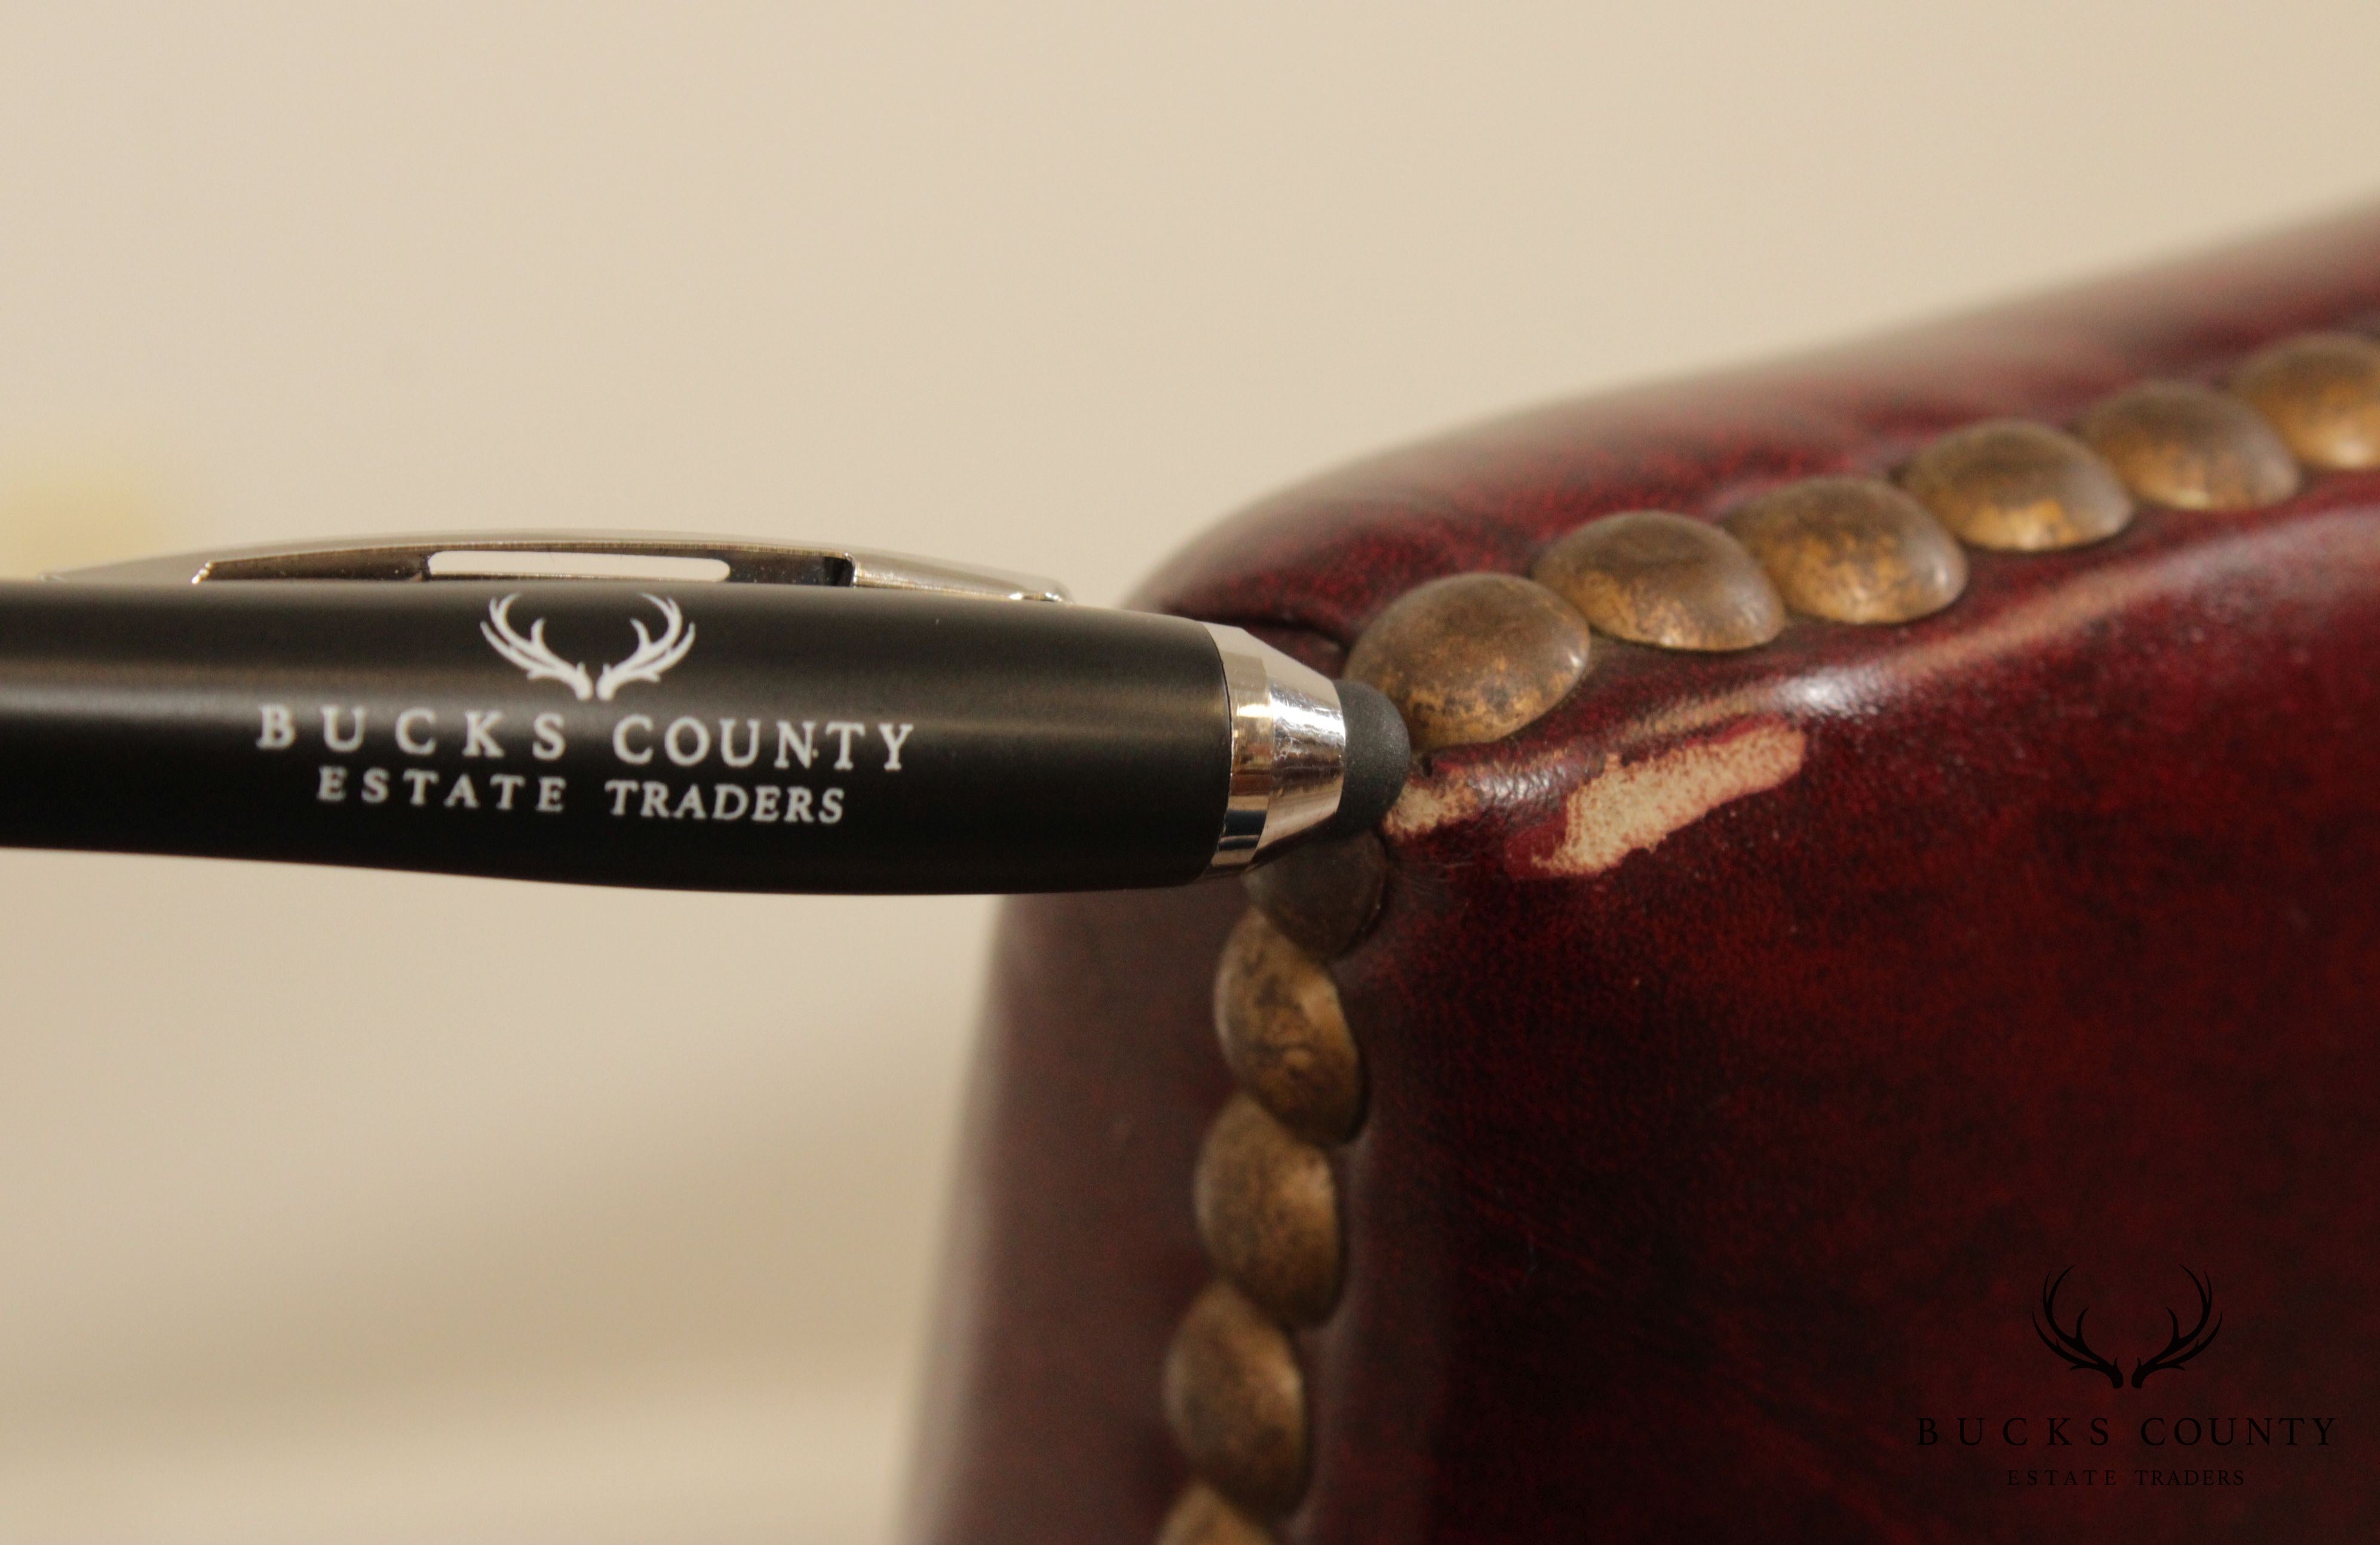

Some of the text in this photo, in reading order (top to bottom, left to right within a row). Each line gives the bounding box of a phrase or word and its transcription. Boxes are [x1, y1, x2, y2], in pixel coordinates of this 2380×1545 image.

[257, 704, 914, 770] BUCKS COUNTY
[318, 766, 844, 824] ESTATE TRADERS
